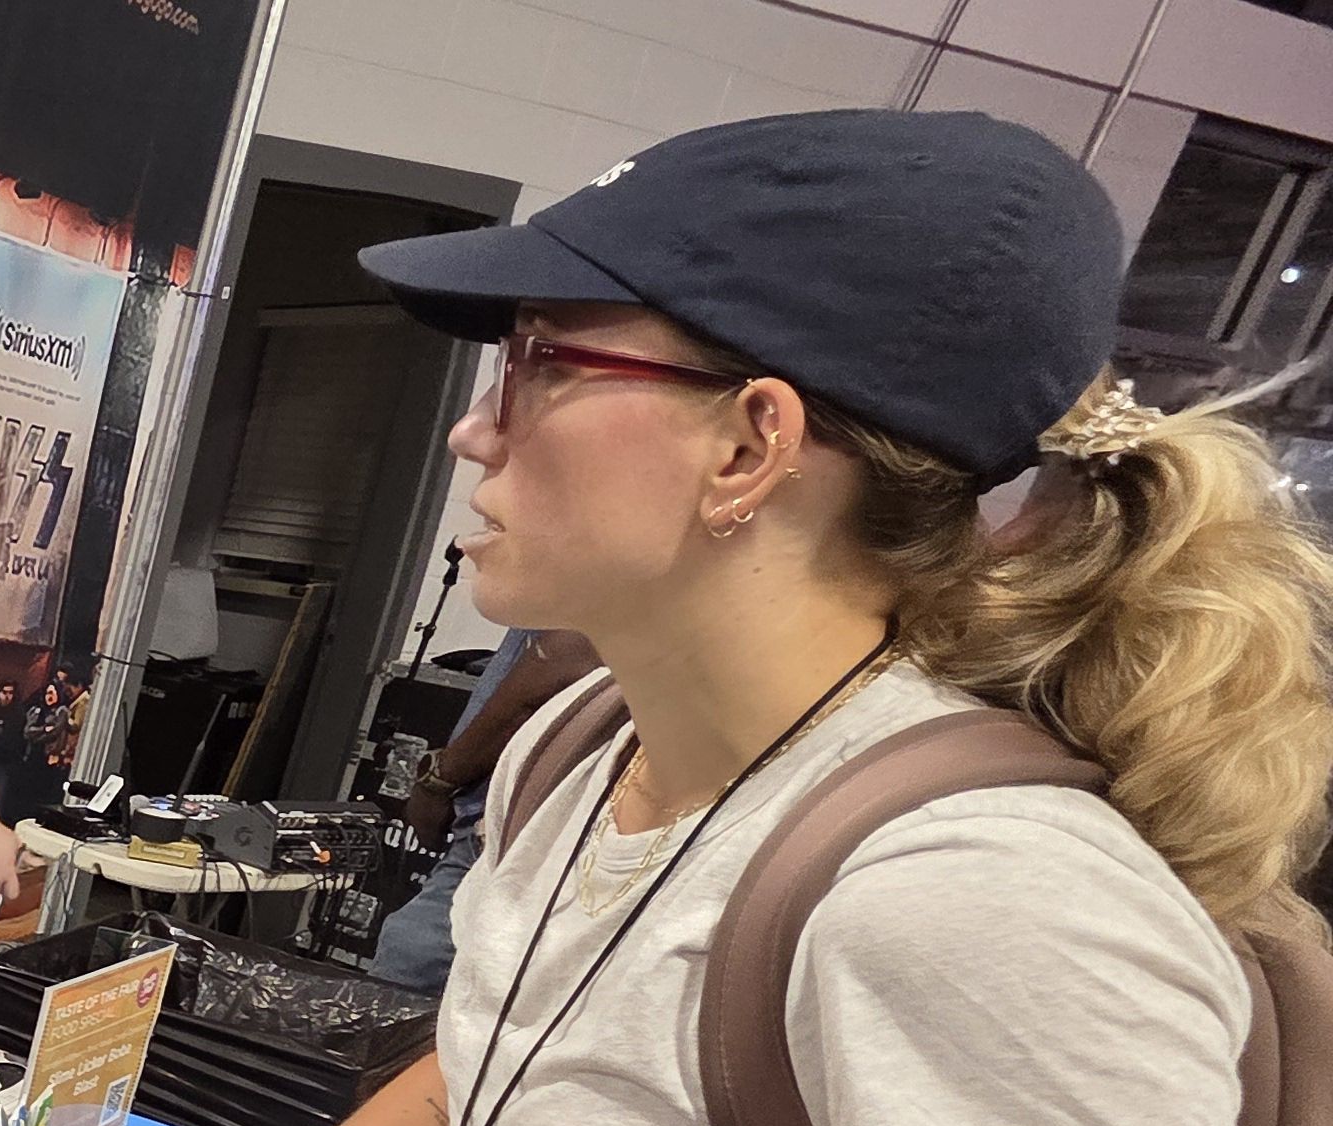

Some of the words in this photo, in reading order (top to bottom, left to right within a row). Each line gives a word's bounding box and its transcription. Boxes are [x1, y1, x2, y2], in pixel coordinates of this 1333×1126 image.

[55, 999, 85, 1022] TASTE
[85, 993, 100, 1010] OF
[100, 986, 119, 1005] THE
